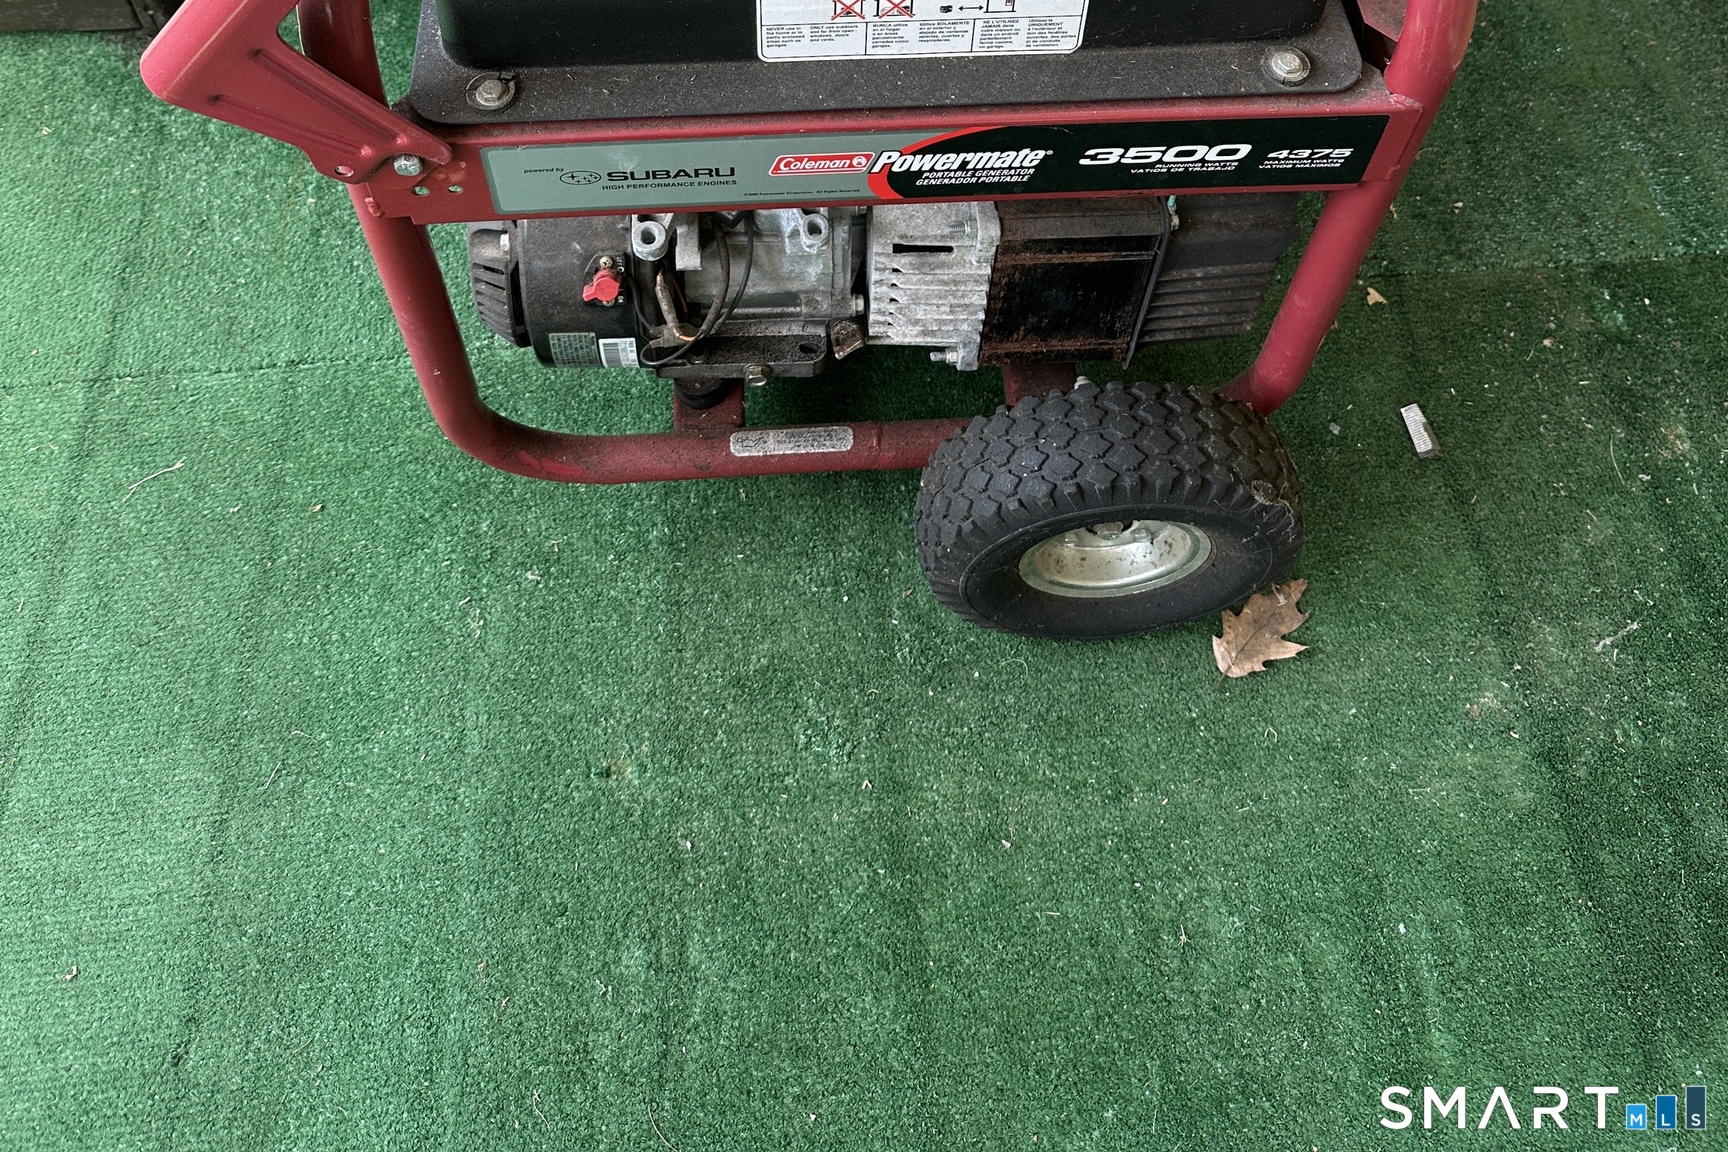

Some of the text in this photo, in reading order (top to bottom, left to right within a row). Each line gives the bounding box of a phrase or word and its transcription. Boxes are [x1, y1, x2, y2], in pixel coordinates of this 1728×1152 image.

[1079, 144, 1252, 165] 3500
[1267, 148, 1354, 158] 4375
[780, 158, 851, 170] Coleman
[607, 167, 735, 181] SUBARU
[922, 168, 1035, 178] PORTABLE GENERATOR
[916, 175, 1030, 186] GENERADOR PORTABLE
